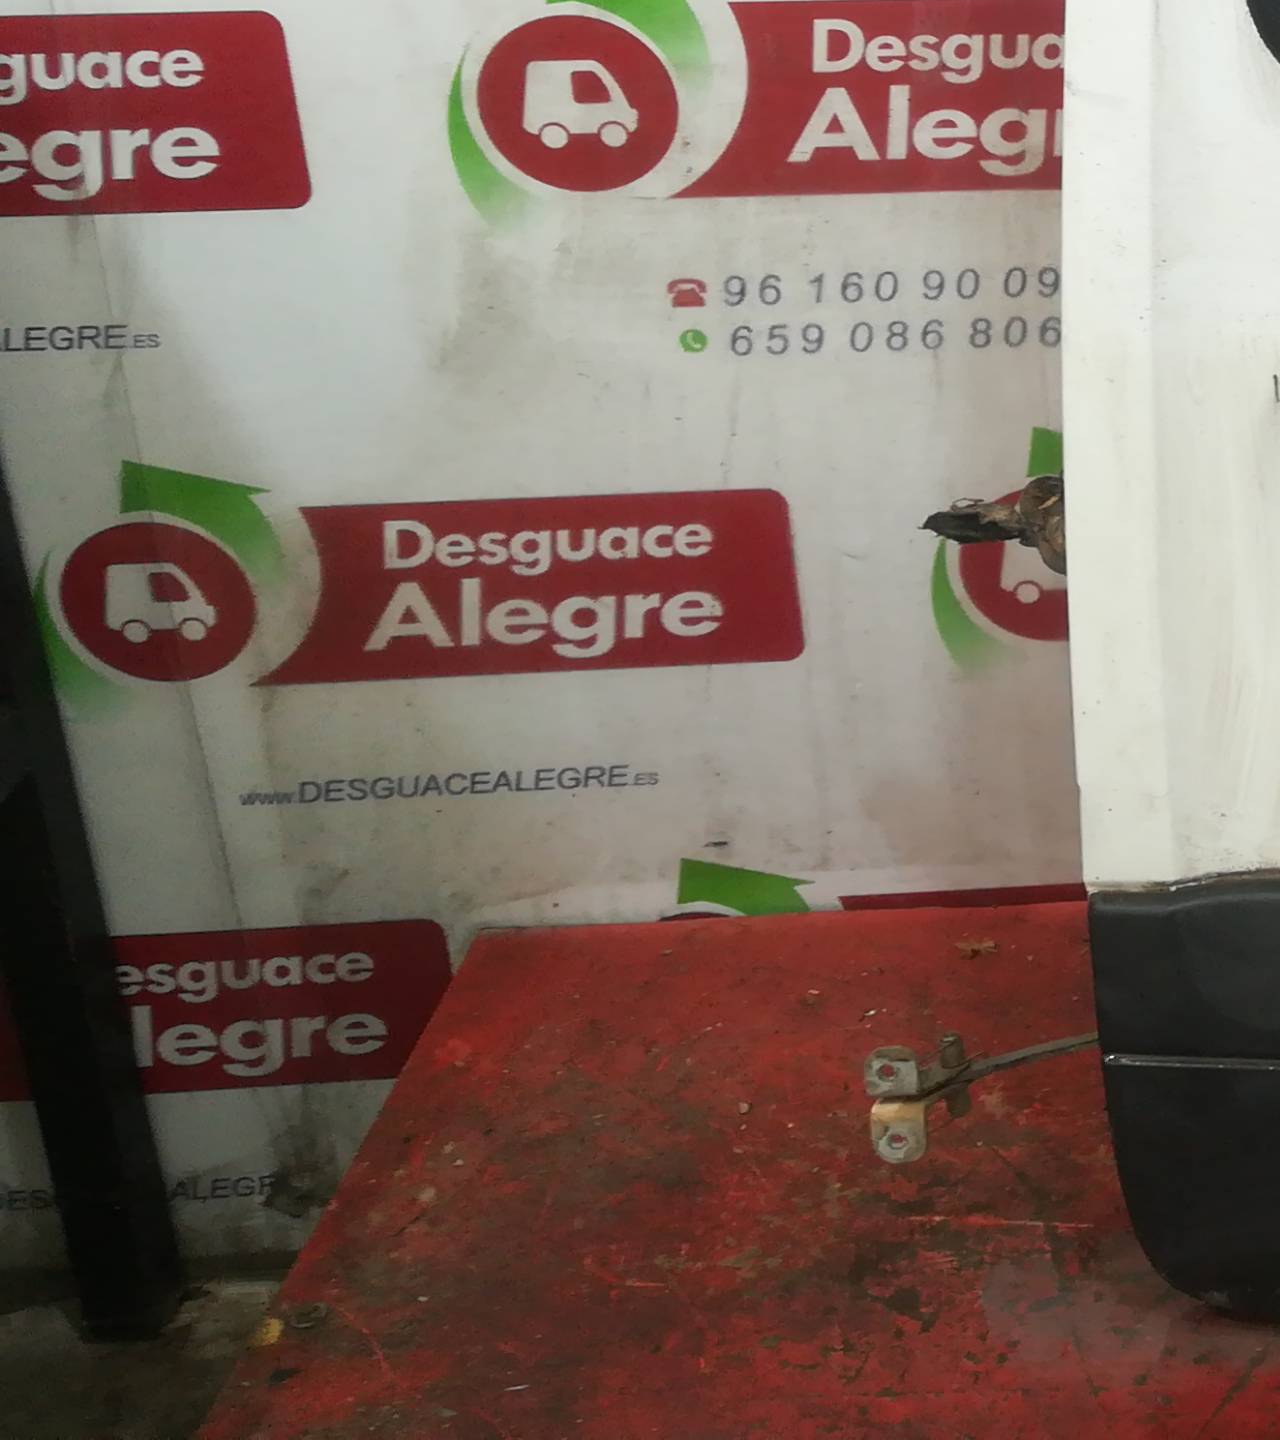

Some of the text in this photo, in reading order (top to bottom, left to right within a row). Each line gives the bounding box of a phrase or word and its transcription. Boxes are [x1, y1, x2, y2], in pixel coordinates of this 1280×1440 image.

[0, 49, 205, 105] guace
[812, 18, 1065, 82] Desgua
[788, 86, 1063, 176] Aleg
[0, 126, 222, 202] egre
[724, 266, 1061, 307] 96 160 90 09
[731, 316, 1063, 356] 659 086 806
[382, 519, 714, 576] Desguace
[363, 578, 725, 659] Alegre
[114, 952, 375, 1003] esguace
[131, 1005, 391, 1077] legre
